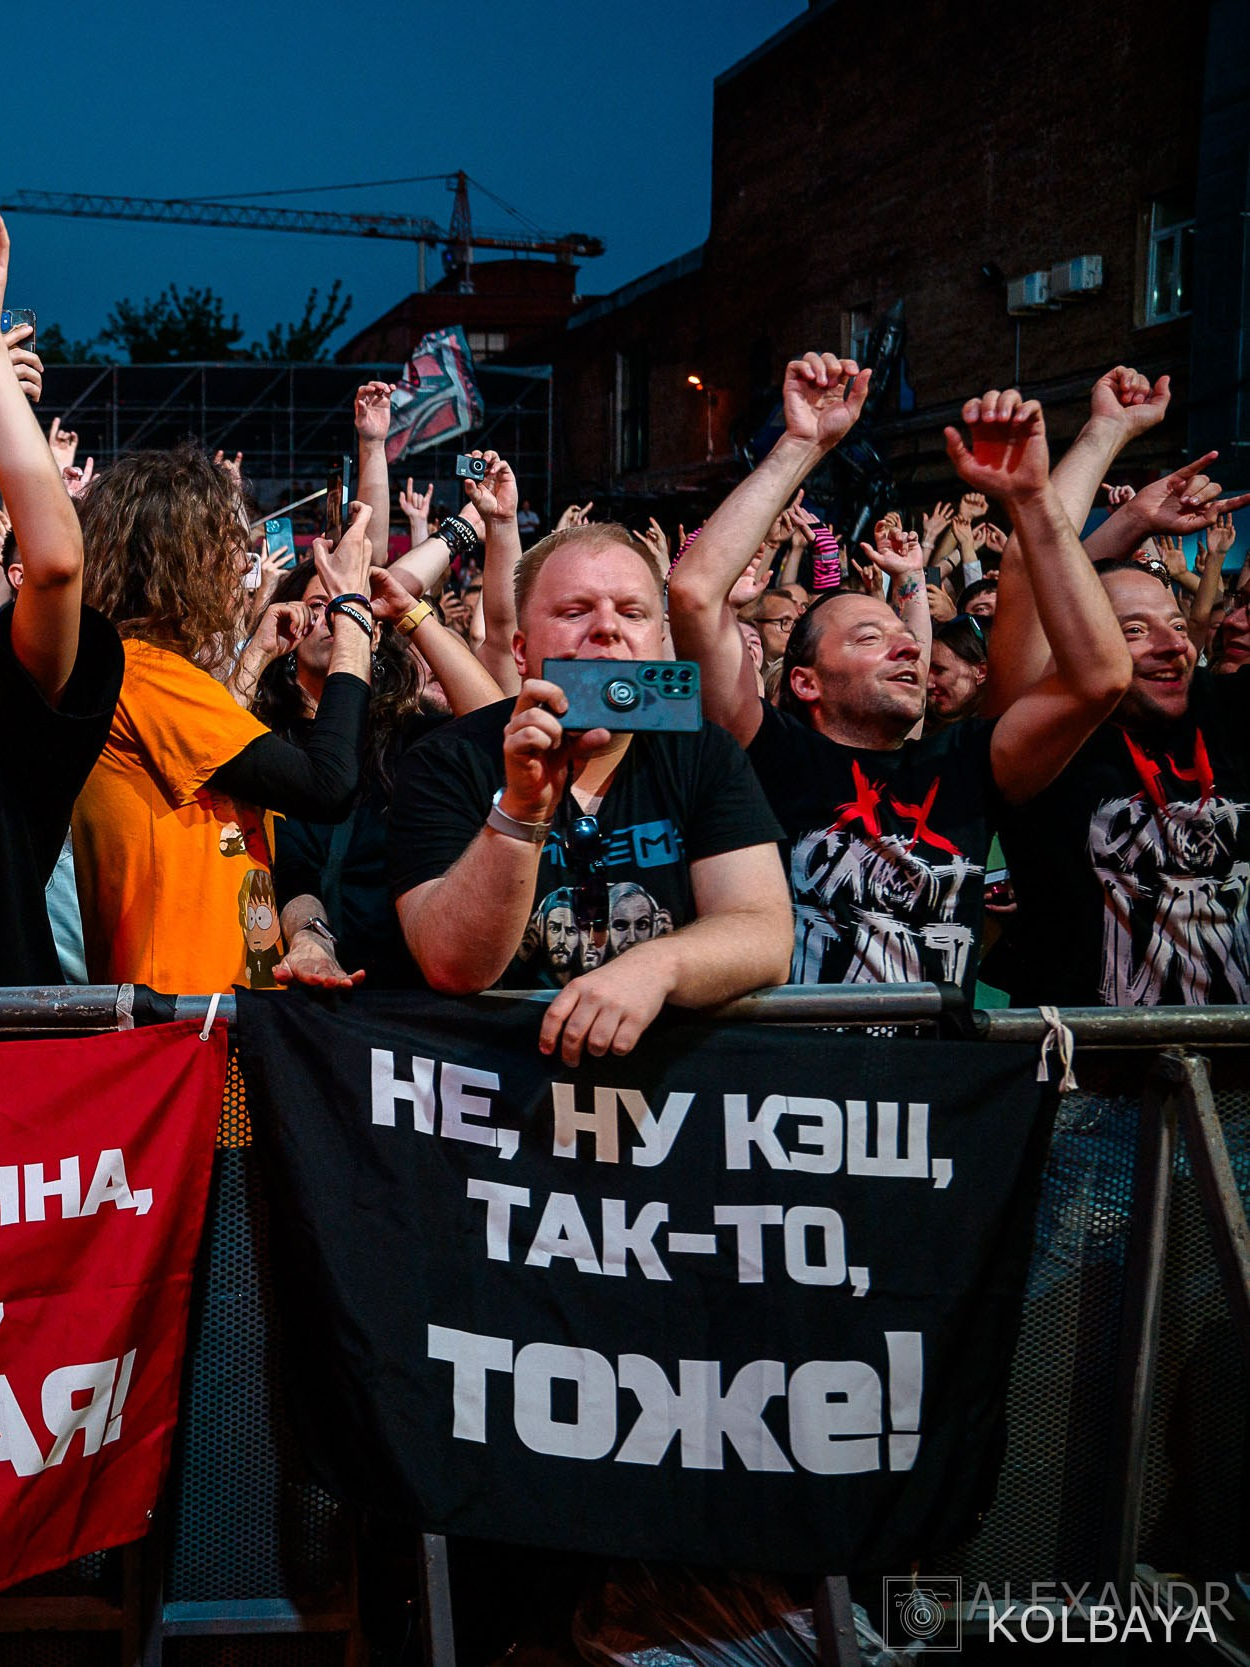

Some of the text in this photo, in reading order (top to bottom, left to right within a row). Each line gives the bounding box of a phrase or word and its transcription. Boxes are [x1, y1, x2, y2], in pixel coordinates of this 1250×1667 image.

[370, 1047, 953, 1189] НЕ, НУ КЭШ,
[466, 1178, 871, 1297] ТАК-ТО,
